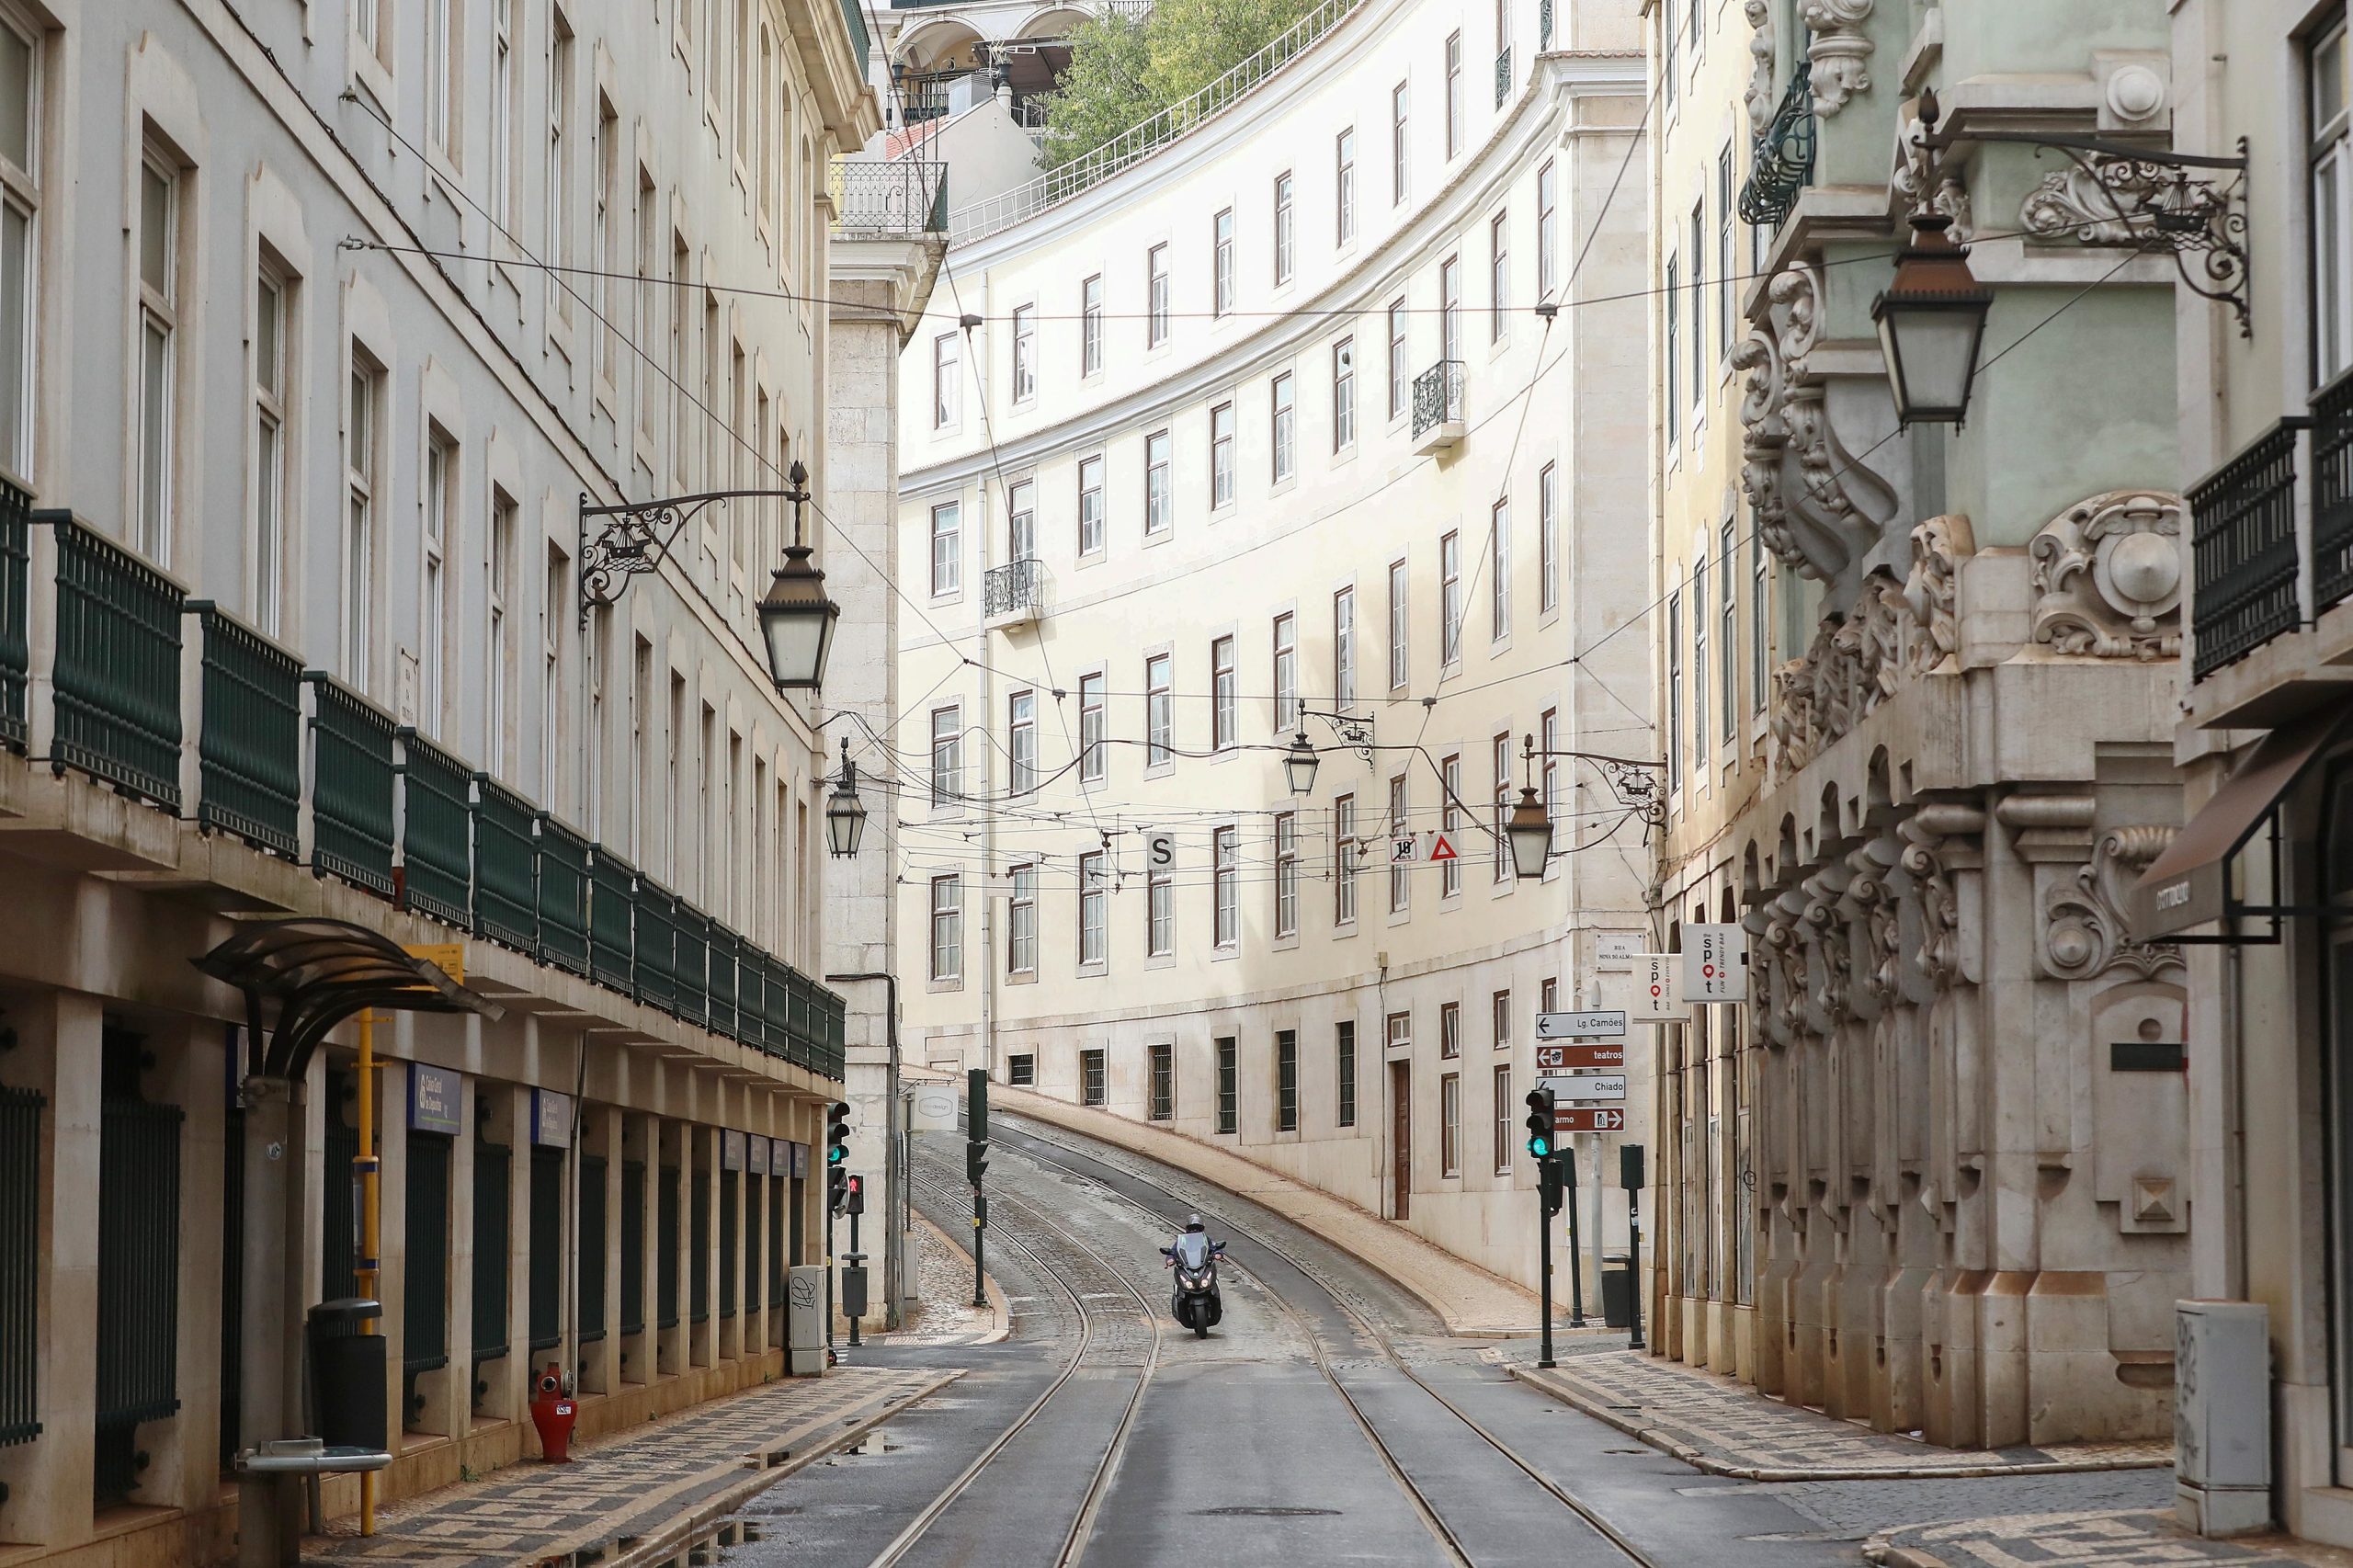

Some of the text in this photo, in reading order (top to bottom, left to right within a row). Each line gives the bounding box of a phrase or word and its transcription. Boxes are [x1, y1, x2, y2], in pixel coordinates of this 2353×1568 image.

[1153, 838, 1172, 864] S
[1577, 1018, 1623, 1028] Lg. Camões
[1594, 1051, 1623, 1060] teatros
[1595, 1083, 1623, 1091] Chiado
[1554, 1116, 1574, 1124] armo
